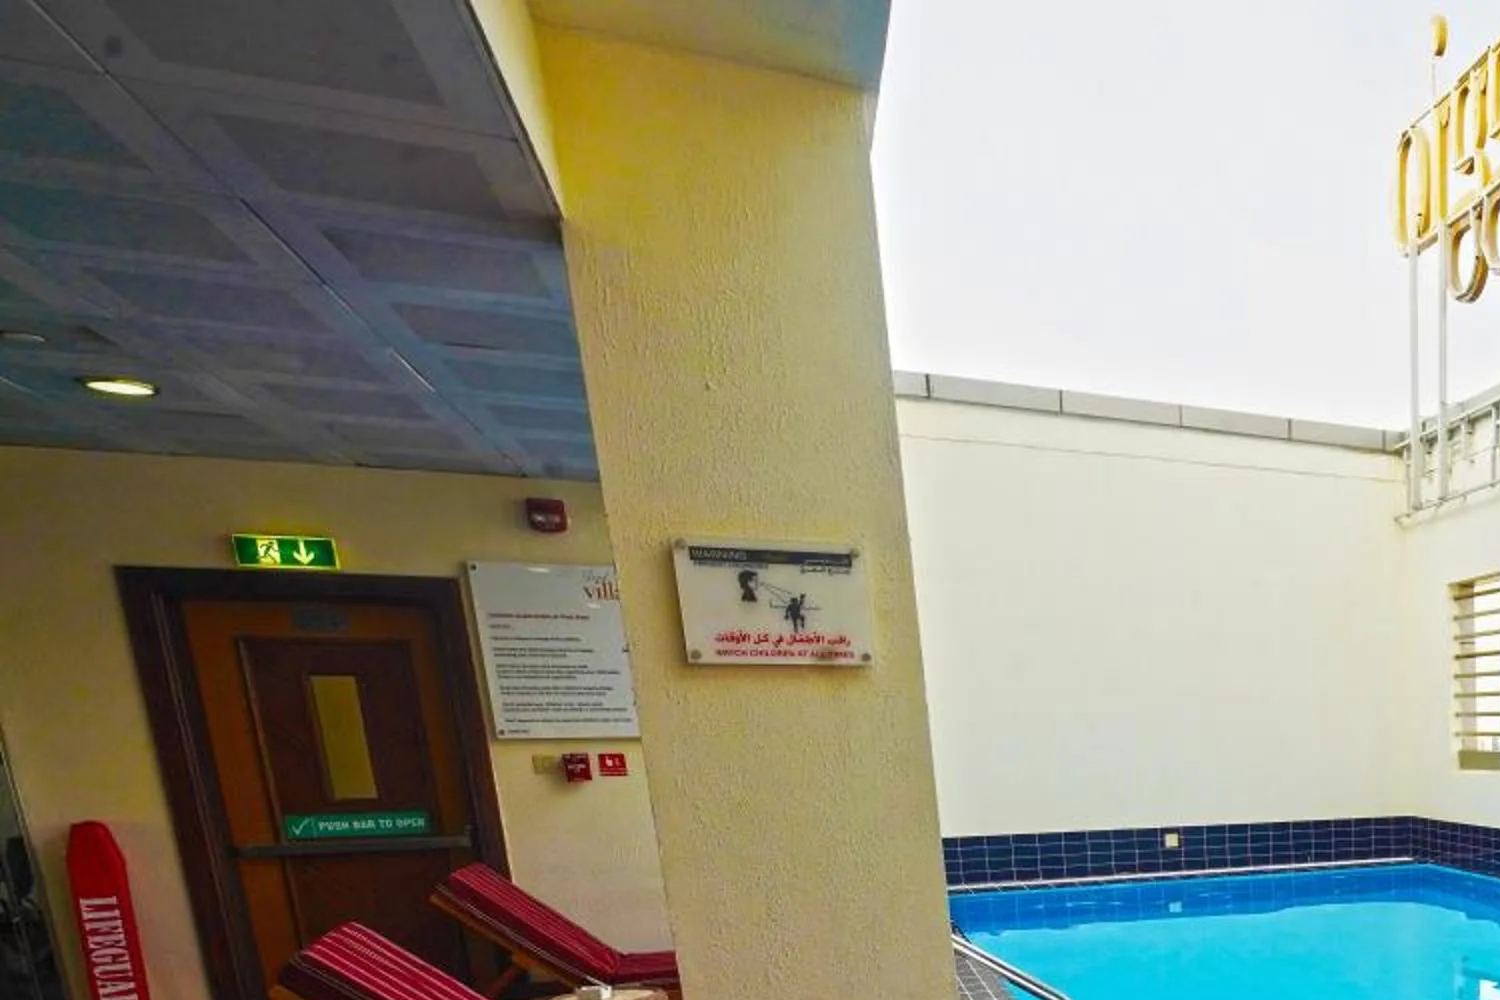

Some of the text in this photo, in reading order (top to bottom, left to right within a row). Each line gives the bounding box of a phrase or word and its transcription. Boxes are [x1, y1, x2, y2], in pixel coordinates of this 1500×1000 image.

[319, 817, 425, 831] PUSH BAR TO OPEN
